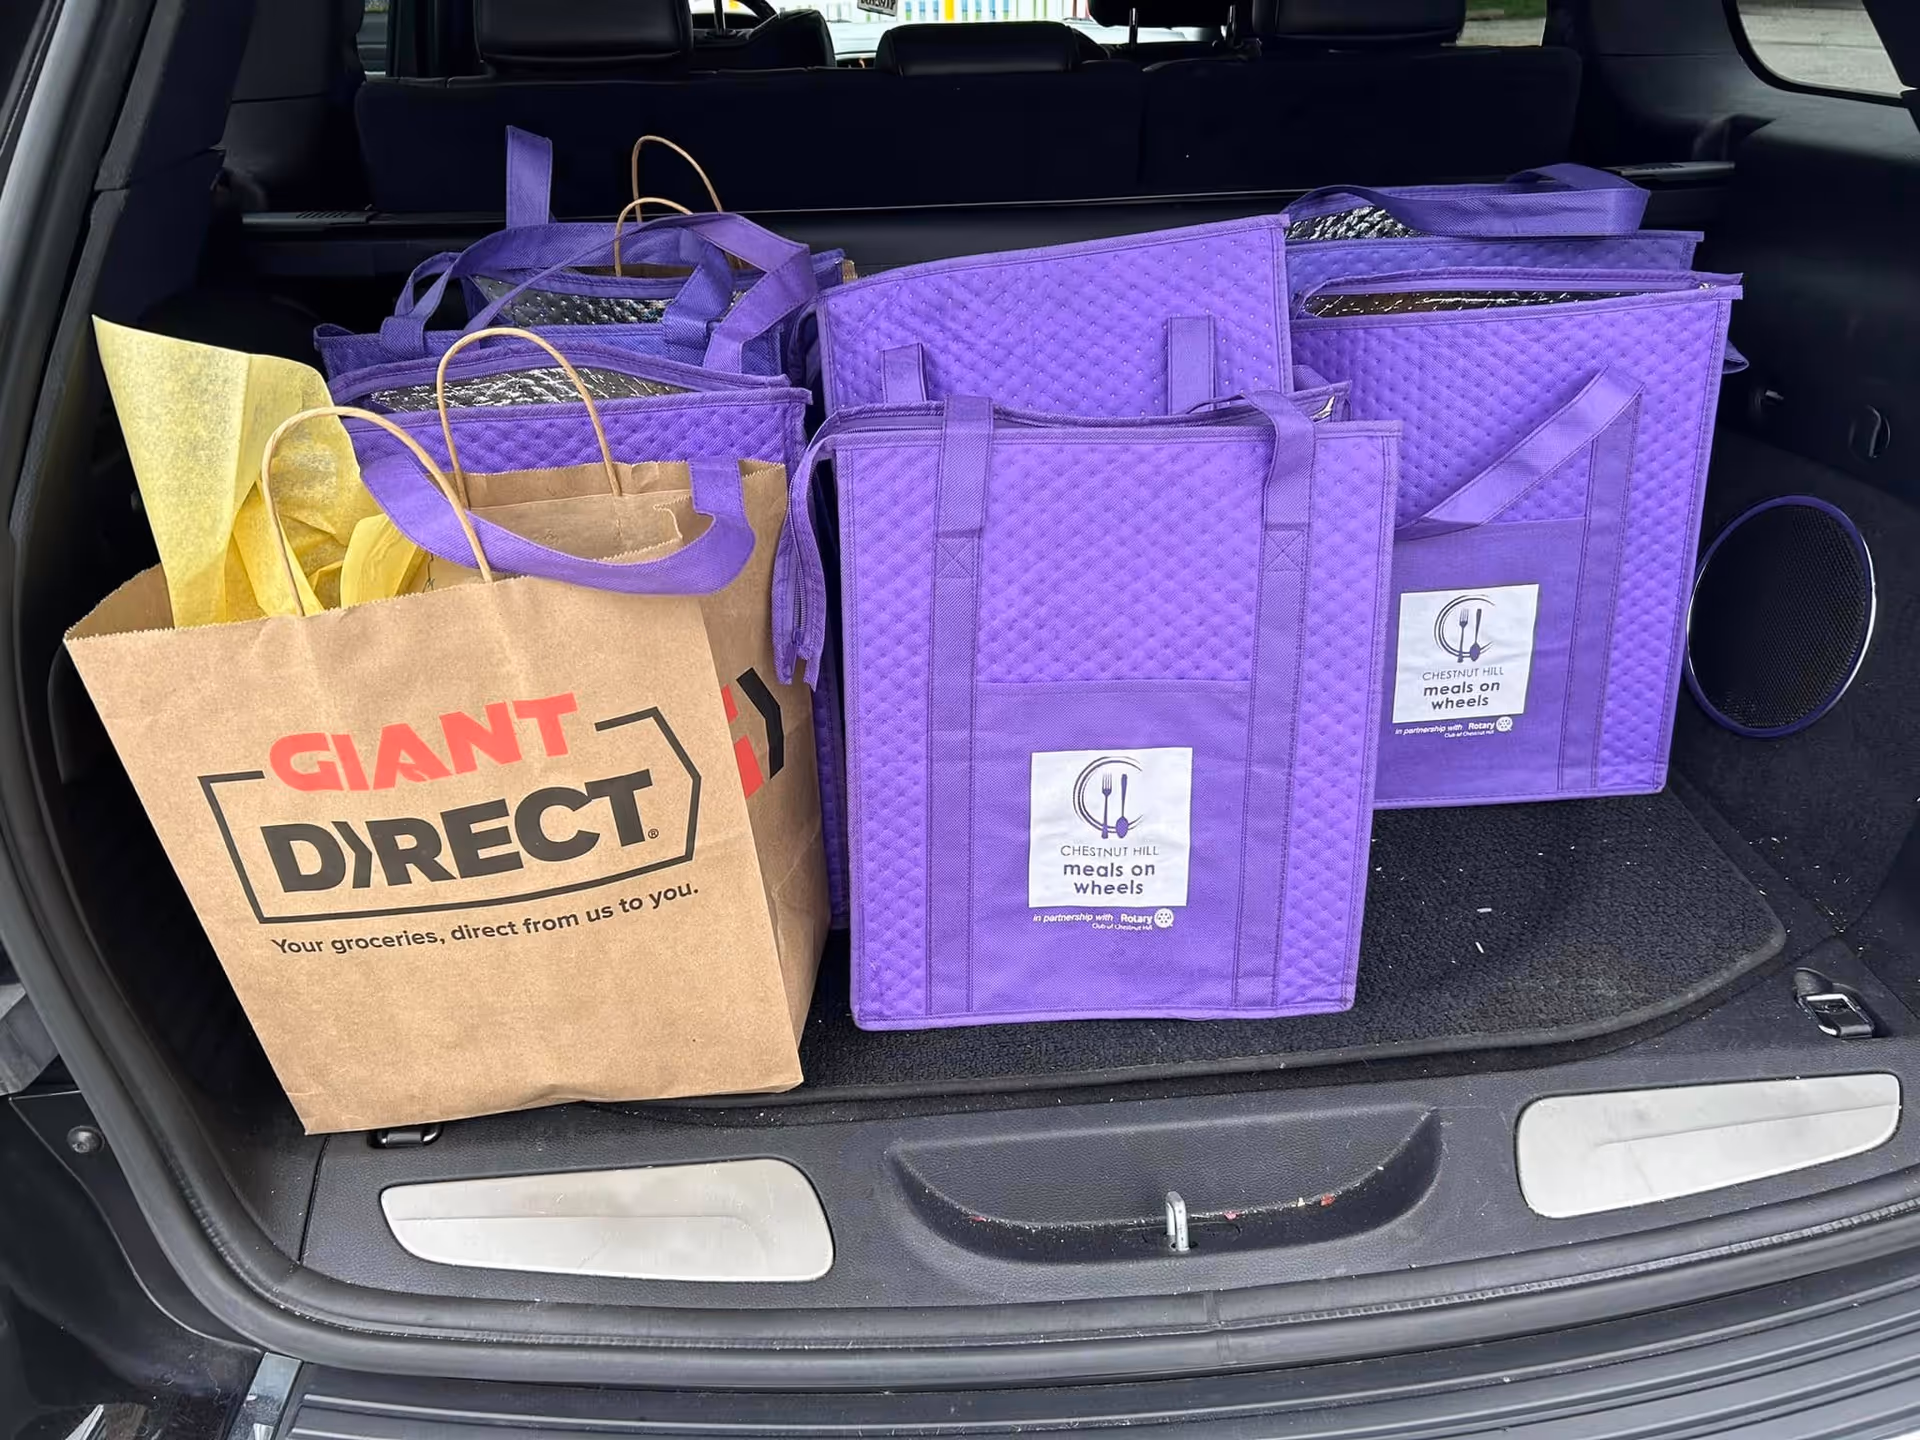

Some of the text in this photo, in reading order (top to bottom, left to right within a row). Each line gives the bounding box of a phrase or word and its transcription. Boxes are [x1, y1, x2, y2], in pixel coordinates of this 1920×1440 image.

[1422, 667, 1504, 681] CHESTNUT HILL
[1424, 681, 1500, 696] meals on
[1431, 695, 1489, 710] wheels
[1403, 726, 1446, 735] partnership
[1468, 722, 1495, 730] Rotary
[269, 692, 577, 791] GIANT
[1060, 845, 1159, 857] CHESTNUT HILL
[1063, 863, 1155, 877] meals on
[1074, 880, 1143, 895] wheels
[272, 883, 699, 955] Your groceries, direct from us to you.
[1033, 912, 1153, 924] in partnership with Rotary
